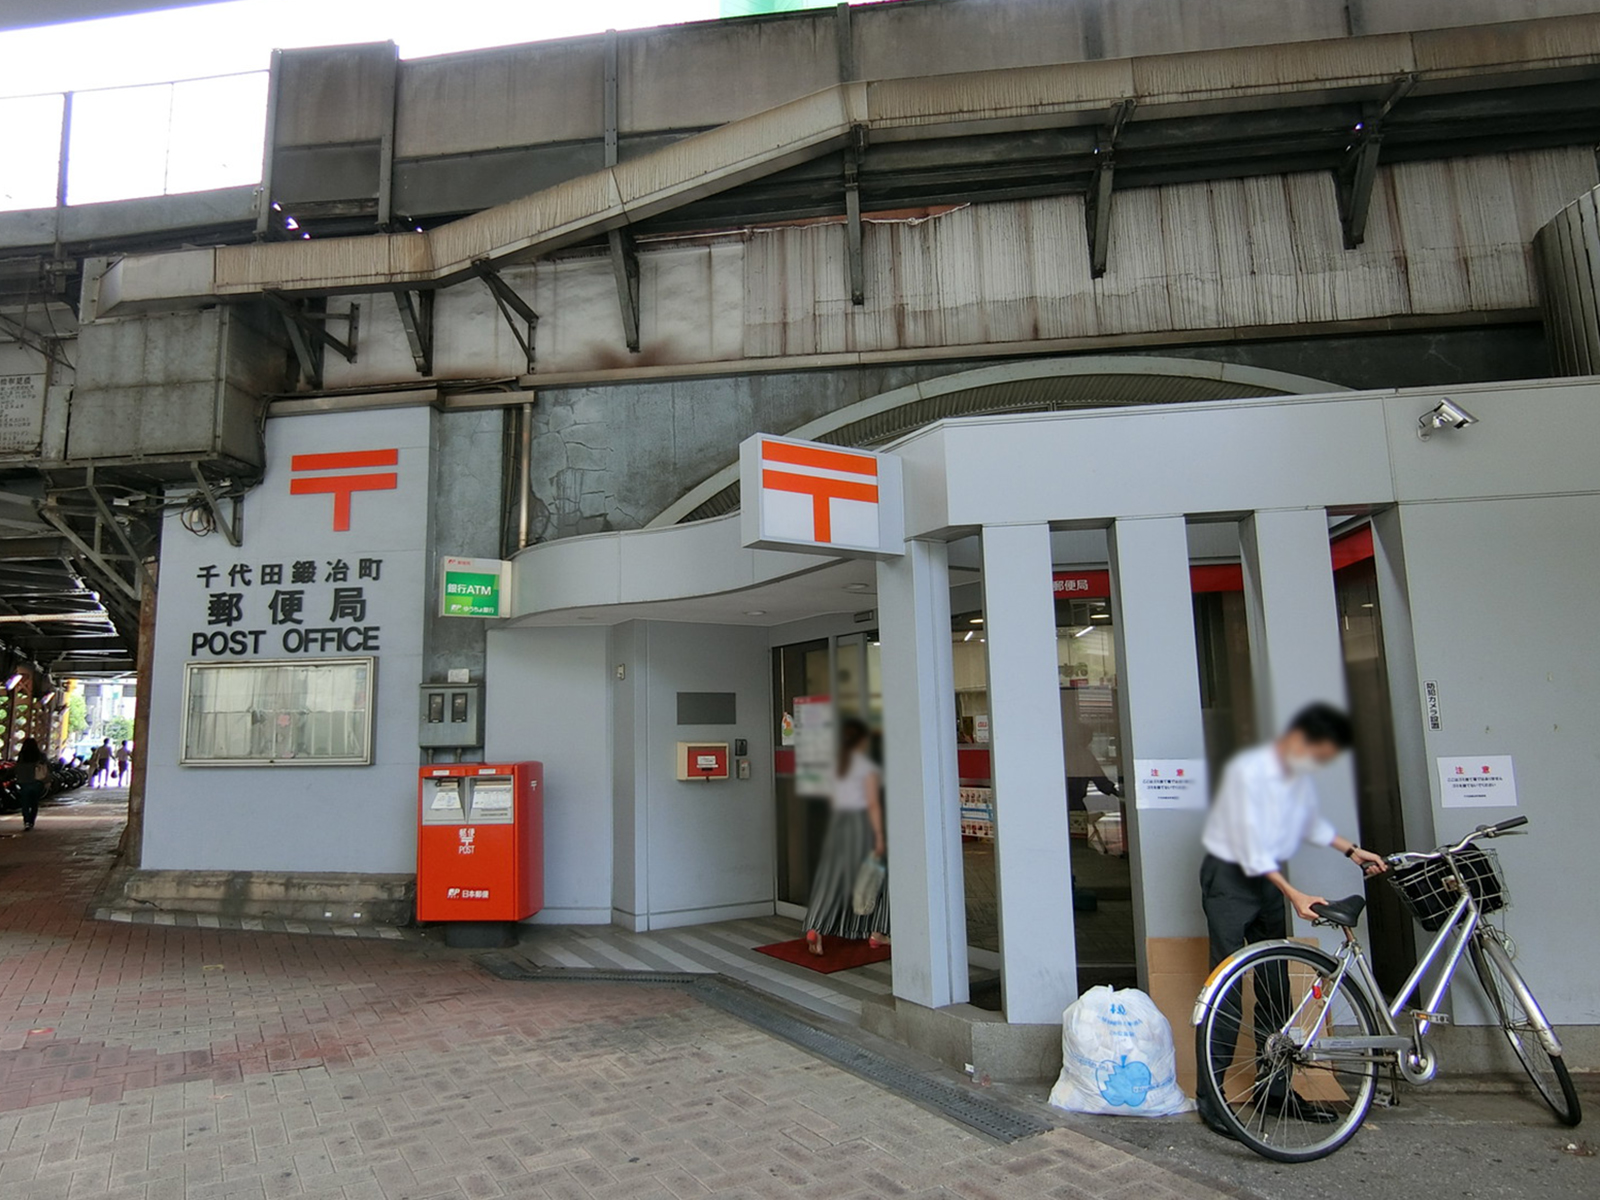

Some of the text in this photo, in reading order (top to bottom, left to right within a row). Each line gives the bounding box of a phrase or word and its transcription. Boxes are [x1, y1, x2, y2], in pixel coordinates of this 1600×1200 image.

[196, 558, 383, 588] 千代田鍛冶町
[447, 583, 492, 596] 銀行ATM
[1053, 579, 1089, 592] 郵便局
[207, 587, 366, 626] 郵便局
[191, 626, 380, 656] POST OFFICE
[1426, 682, 1440, 730] 防犯カメラ設置
[459, 828, 475, 837] 郵便
[458, 845, 475, 854] POST
[461, 889, 490, 899] 日本郵便
